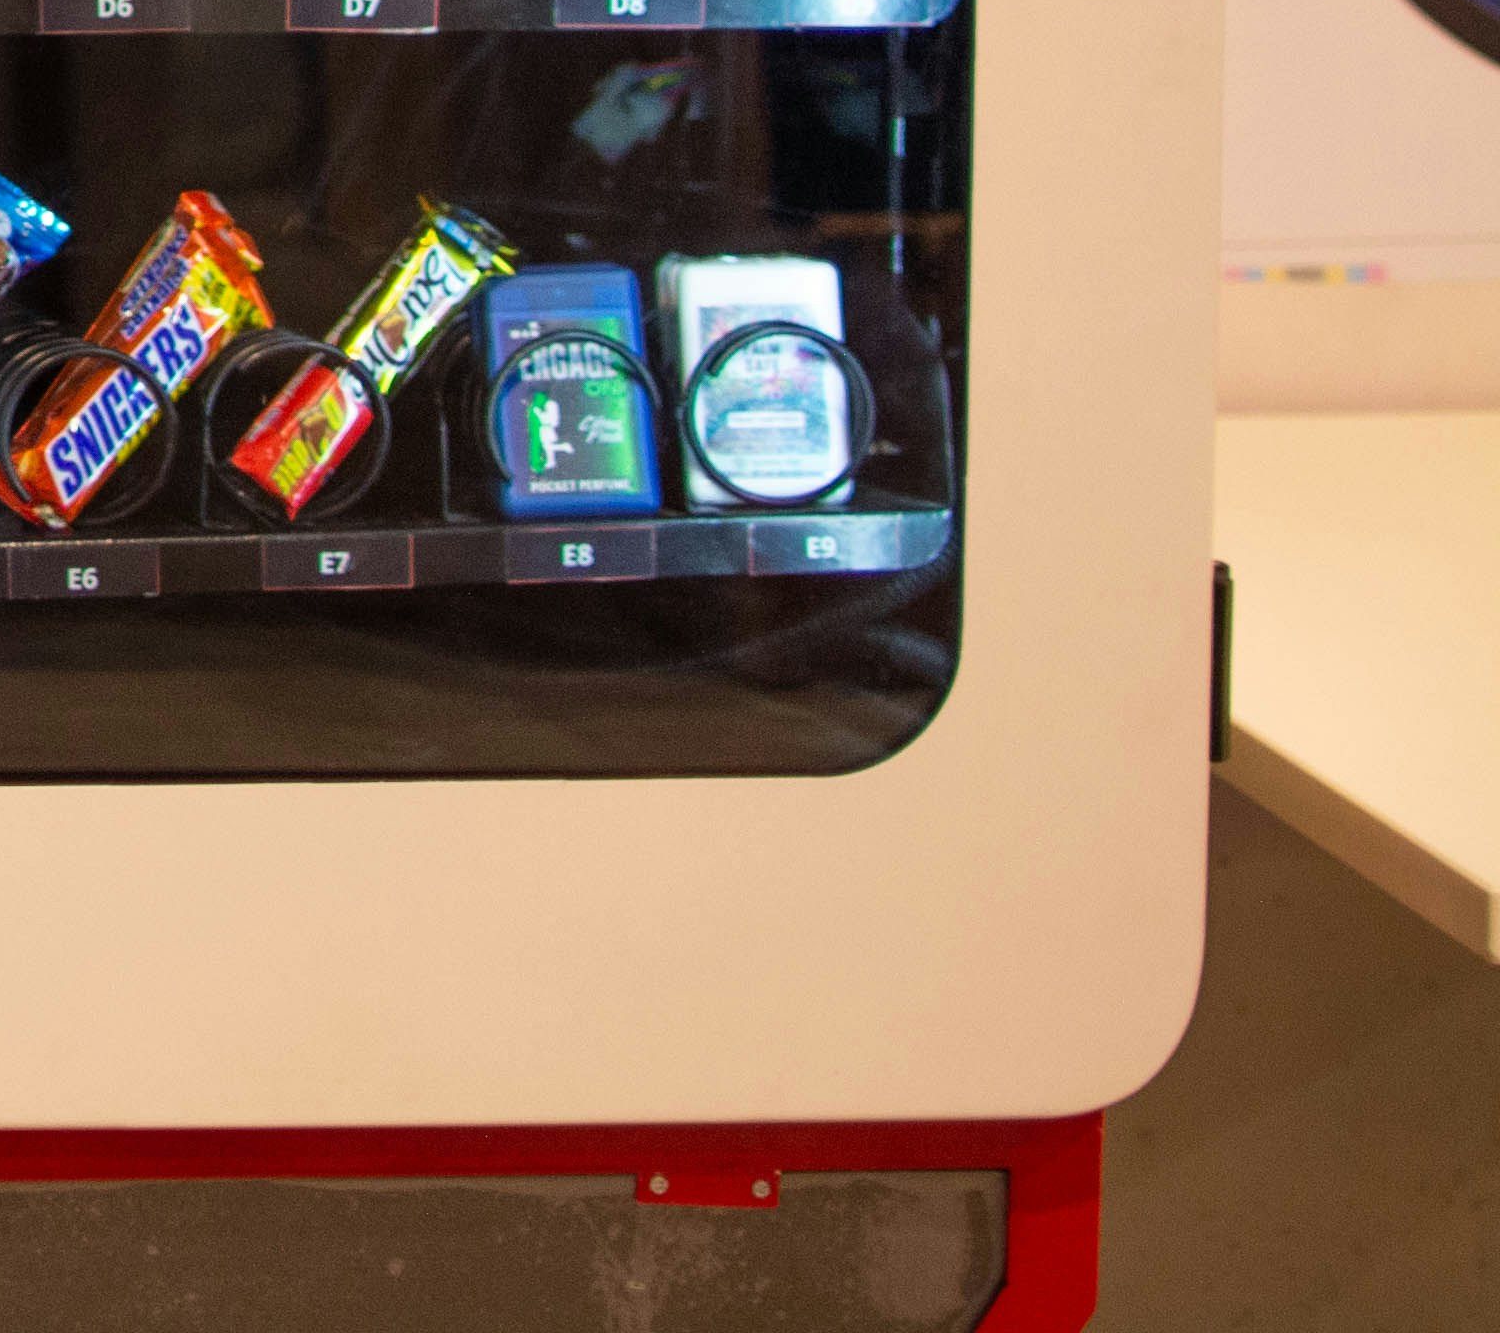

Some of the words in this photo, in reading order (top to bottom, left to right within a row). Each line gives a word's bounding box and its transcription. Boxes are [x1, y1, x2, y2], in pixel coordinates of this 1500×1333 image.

[48, 305, 210, 506] SNICKERS
[561, 543, 596, 567] E8
[806, 536, 839, 560] E9
[318, 551, 352, 574] E7
[67, 567, 100, 590] E6
